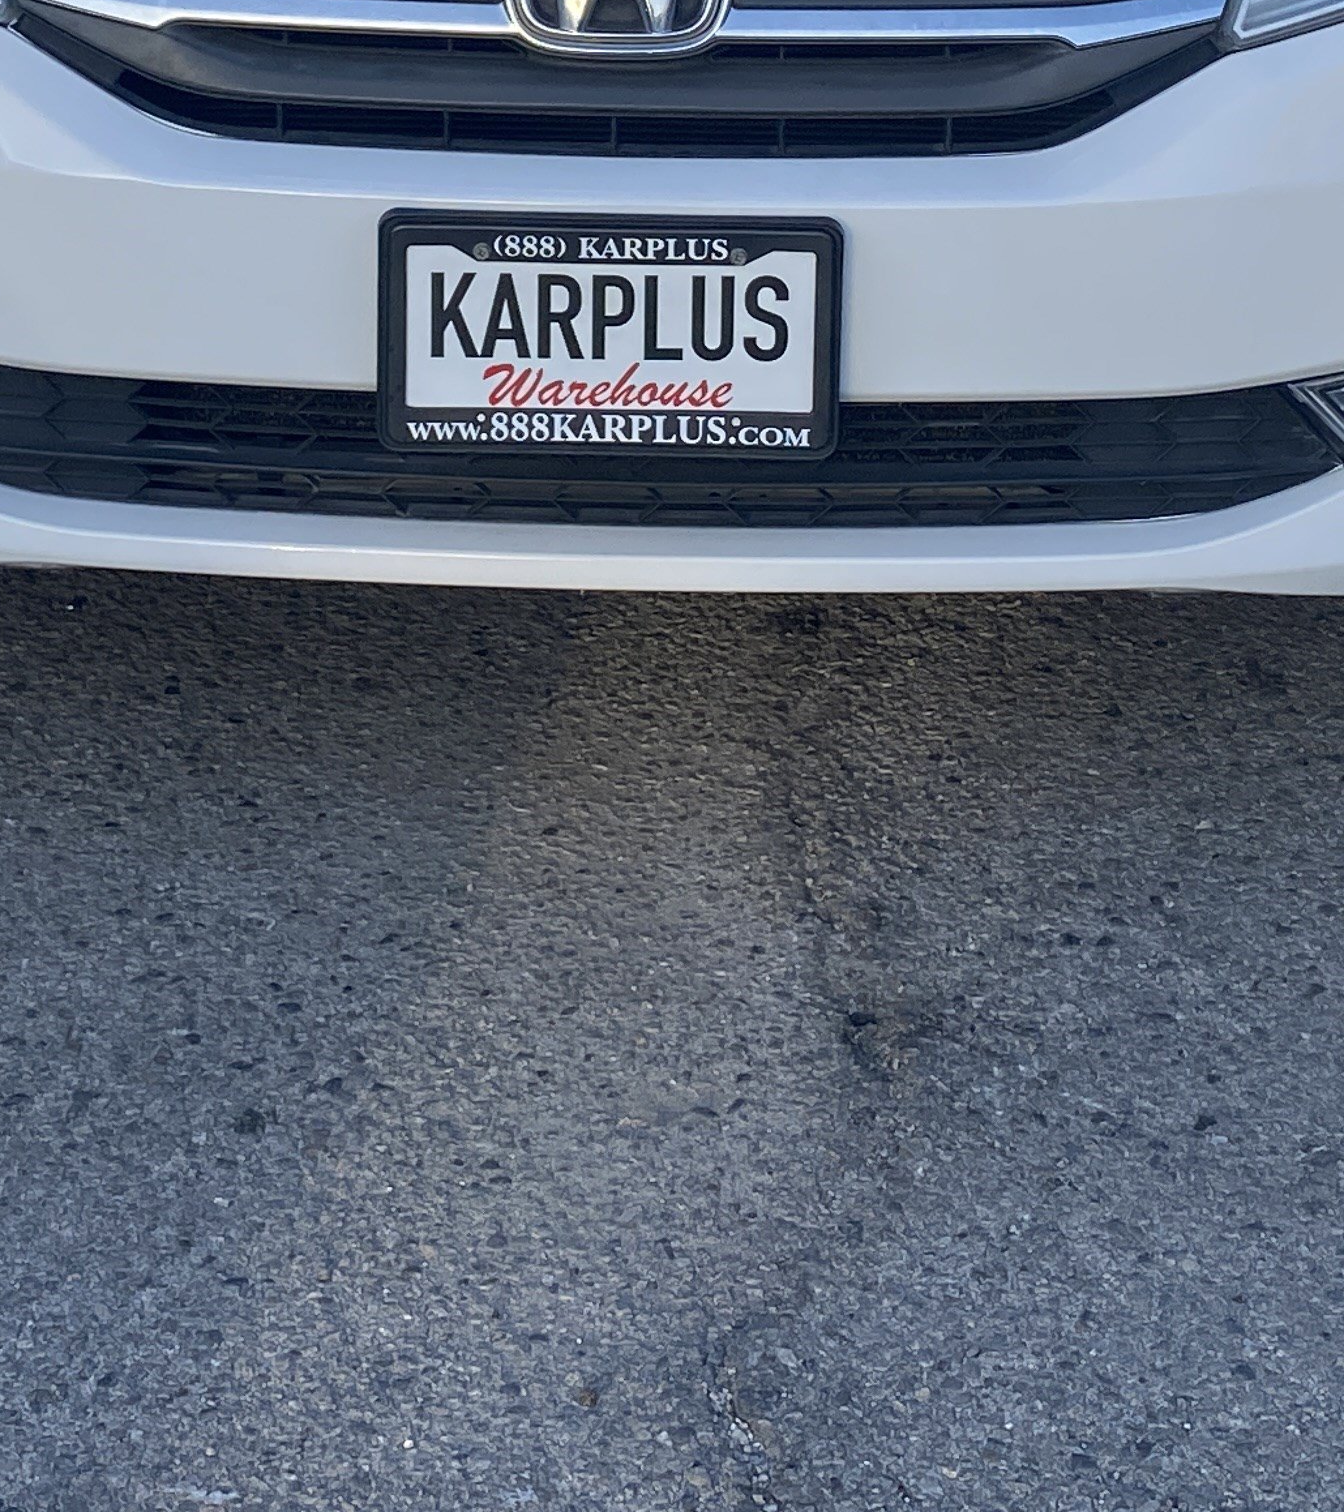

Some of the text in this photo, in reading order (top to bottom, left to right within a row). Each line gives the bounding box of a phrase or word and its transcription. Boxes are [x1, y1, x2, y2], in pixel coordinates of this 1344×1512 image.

[493, 234, 729, 262] (888) KARPLUS
[430, 271, 791, 362] KARPLUS
[482, 362, 735, 408] Warehouse
